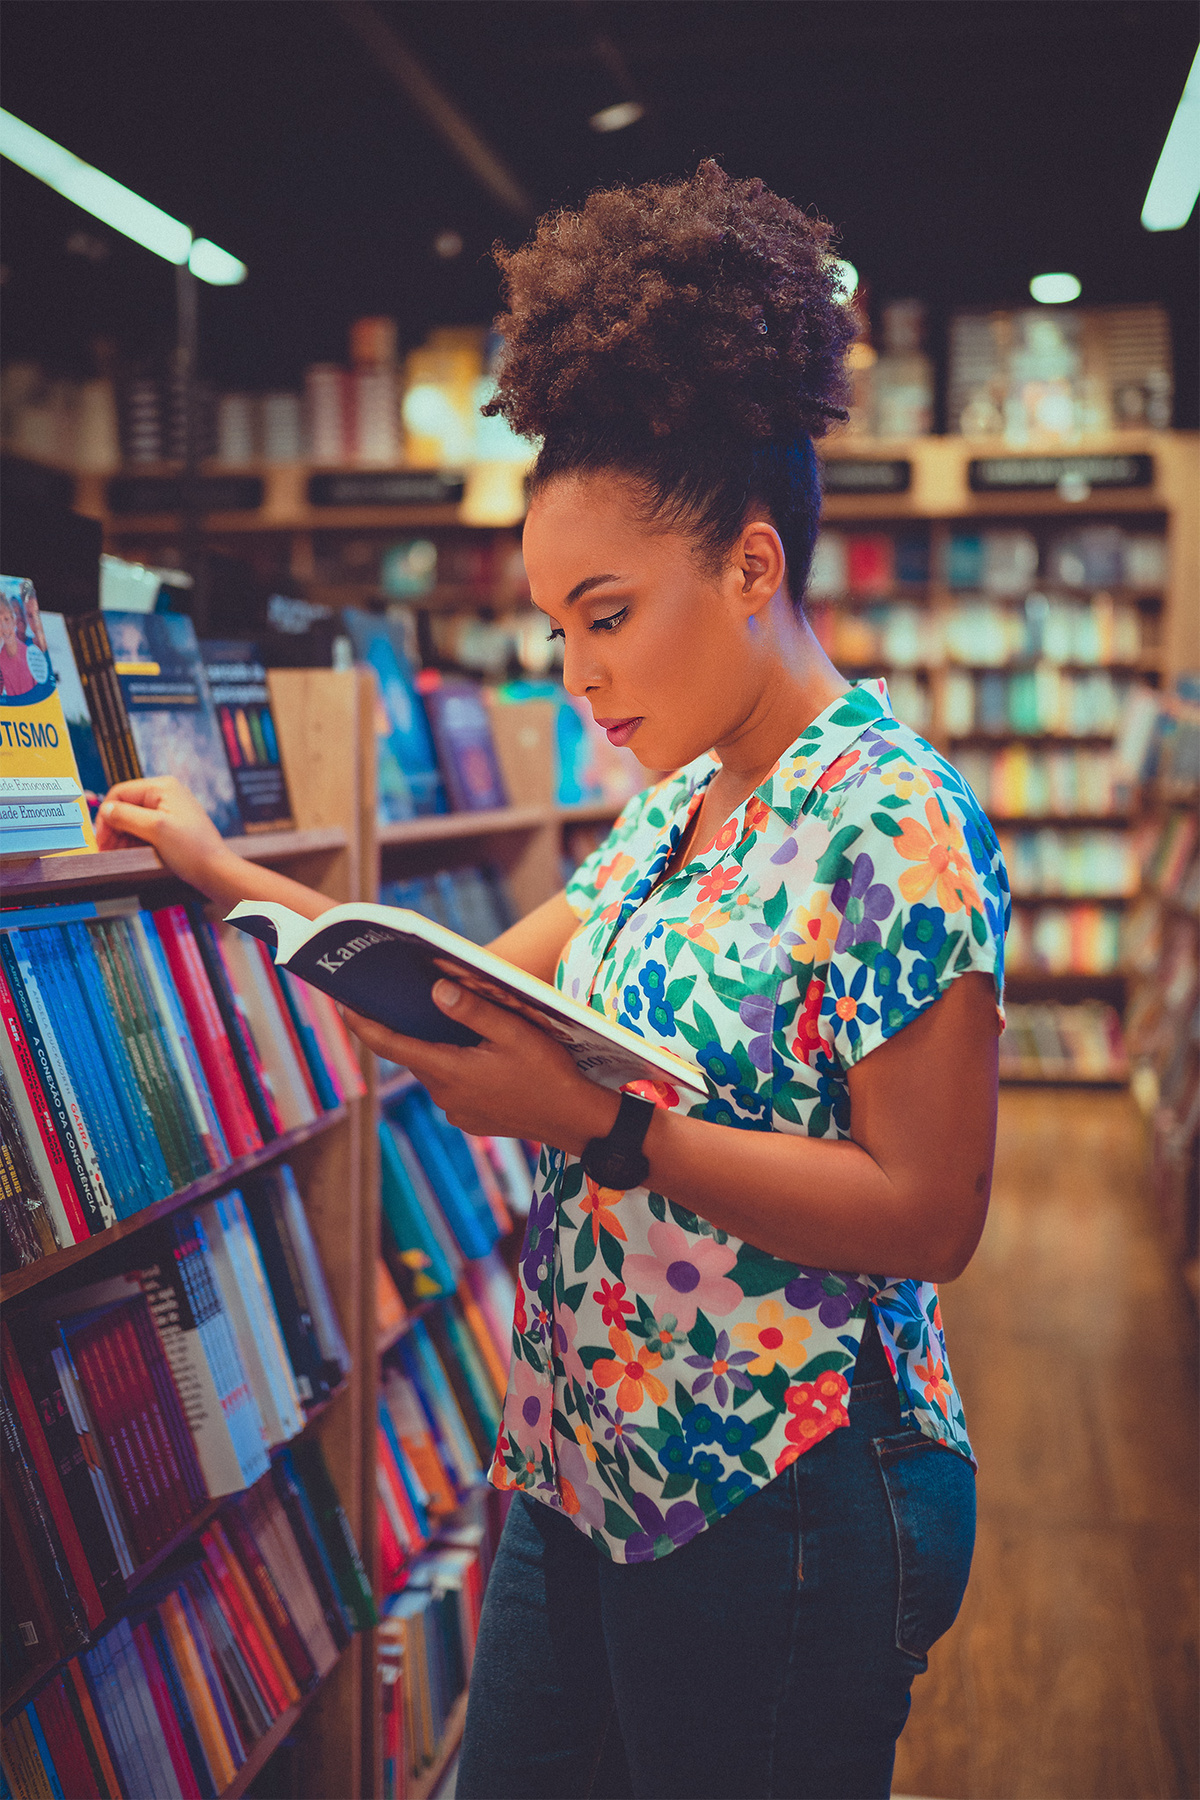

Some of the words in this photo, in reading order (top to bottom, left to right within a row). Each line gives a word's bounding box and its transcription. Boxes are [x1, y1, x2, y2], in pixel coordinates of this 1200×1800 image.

[0, 720, 59, 748] TISMO
[14, 779, 62, 791] Emocional
[0, 806, 18, 820] ade
[19, 804, 65, 819] Emocional
[8, 959, 21, 988] LARRY
[18, 990, 33, 1024] DOSSEY
[32, 990, 49, 1030] ANGELA
[46, 1032, 71, 1095] DUCKWORTH
[8, 1017, 20, 1042] LER
[40, 1115, 60, 1166] PESSOAS
[33, 1036, 40, 1046] A
[38, 1048, 62, 1108] CONEXÃO
[58, 1111, 68, 1129] DA
[65, 1131, 97, 1214] CONSCIÊNCIA
[43, 1111, 54, 1132] FBI
[70, 1103, 89, 1150] GARRA
